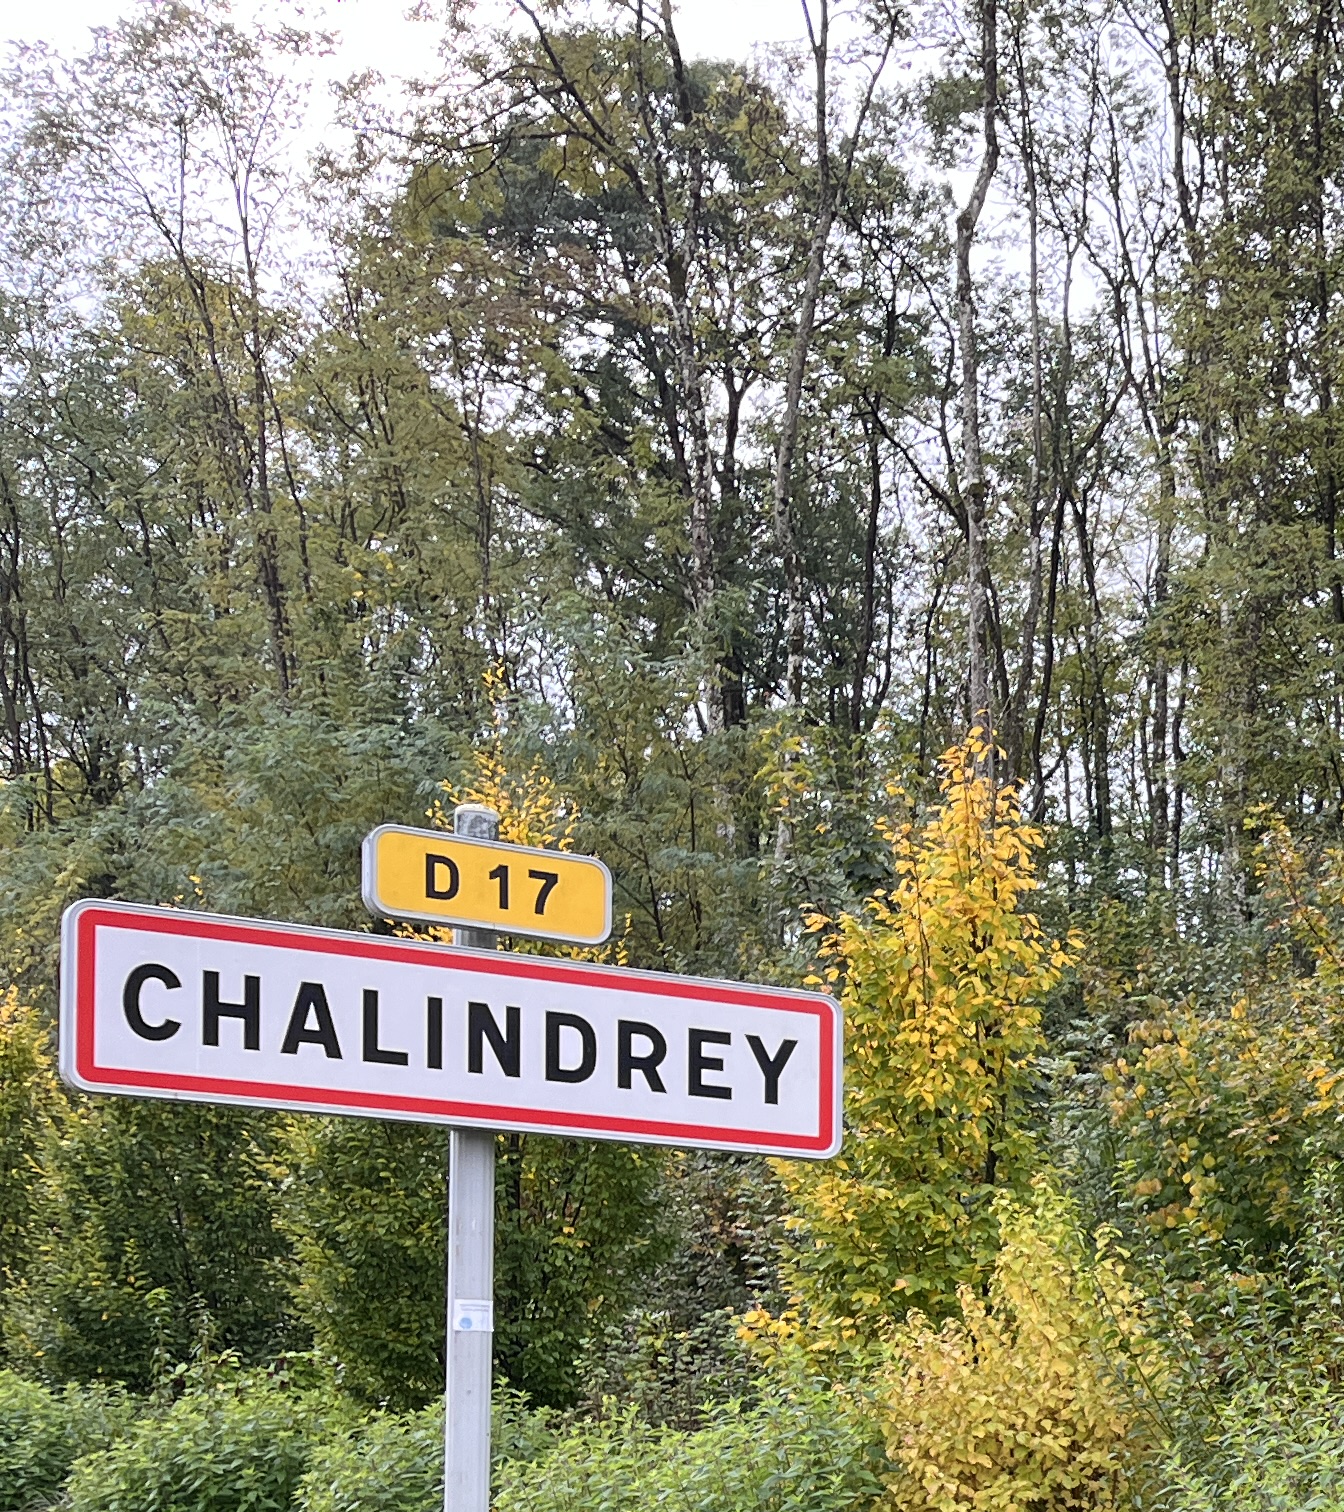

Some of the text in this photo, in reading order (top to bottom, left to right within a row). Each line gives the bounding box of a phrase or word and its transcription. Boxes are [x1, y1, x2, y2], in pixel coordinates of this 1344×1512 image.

[425, 853, 560, 916] D 17
[123, 963, 798, 1105] CHALINDREY
